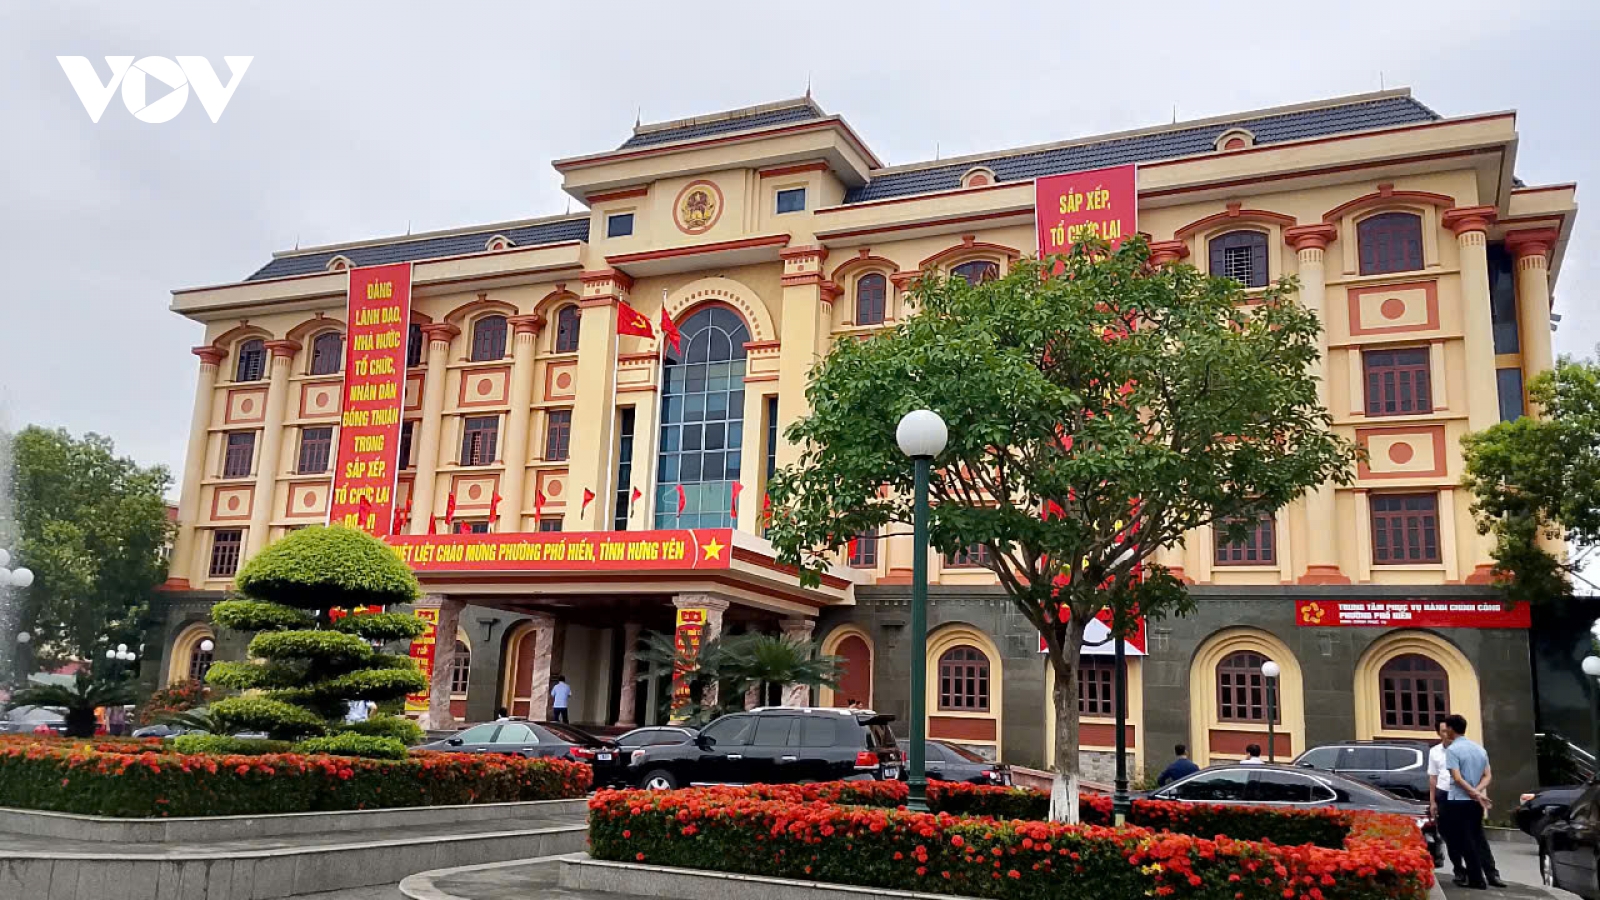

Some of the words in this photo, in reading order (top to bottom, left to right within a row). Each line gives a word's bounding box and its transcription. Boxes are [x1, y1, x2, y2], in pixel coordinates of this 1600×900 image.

[1059, 187, 1083, 214] SẮP
[1086, 184, 1111, 211] XẾP,
[1050, 219, 1065, 246] TỔ
[1102, 219, 1121, 243] LẠI
[367, 277, 392, 300] ĐẢNG
[355, 306, 380, 326] LÃNH
[381, 305, 402, 326] ĐẠO,
[354, 330, 374, 351] NHÀ
[376, 328, 401, 350] NƯỚC
[355, 354, 368, 376] TỔ
[369, 354, 396, 376] CHỨC,
[350, 382, 377, 401] NHÂN
[378, 380, 397, 400] DÂN
[371, 404, 399, 429] THUẬN
[354, 434, 385, 452] TRONG
[345, 455, 366, 479] SẮP
[367, 455, 386, 479] XẾP,
[335, 482, 349, 505] TỔ
[375, 486, 390, 507] LẠI
[414, 540, 435, 566] LIỆT
[436, 541, 464, 562] CHÀO
[465, 540, 497, 561] MỪNG
[498, 539, 541, 561] PHƯỜNG
[543, 537, 566, 561] PHỐ
[567, 537, 596, 563] HIẾN,
[600, 537, 625, 561] TỈNH
[627, 539, 659, 561] HƯNG
[661, 538, 685, 560] YÊN
